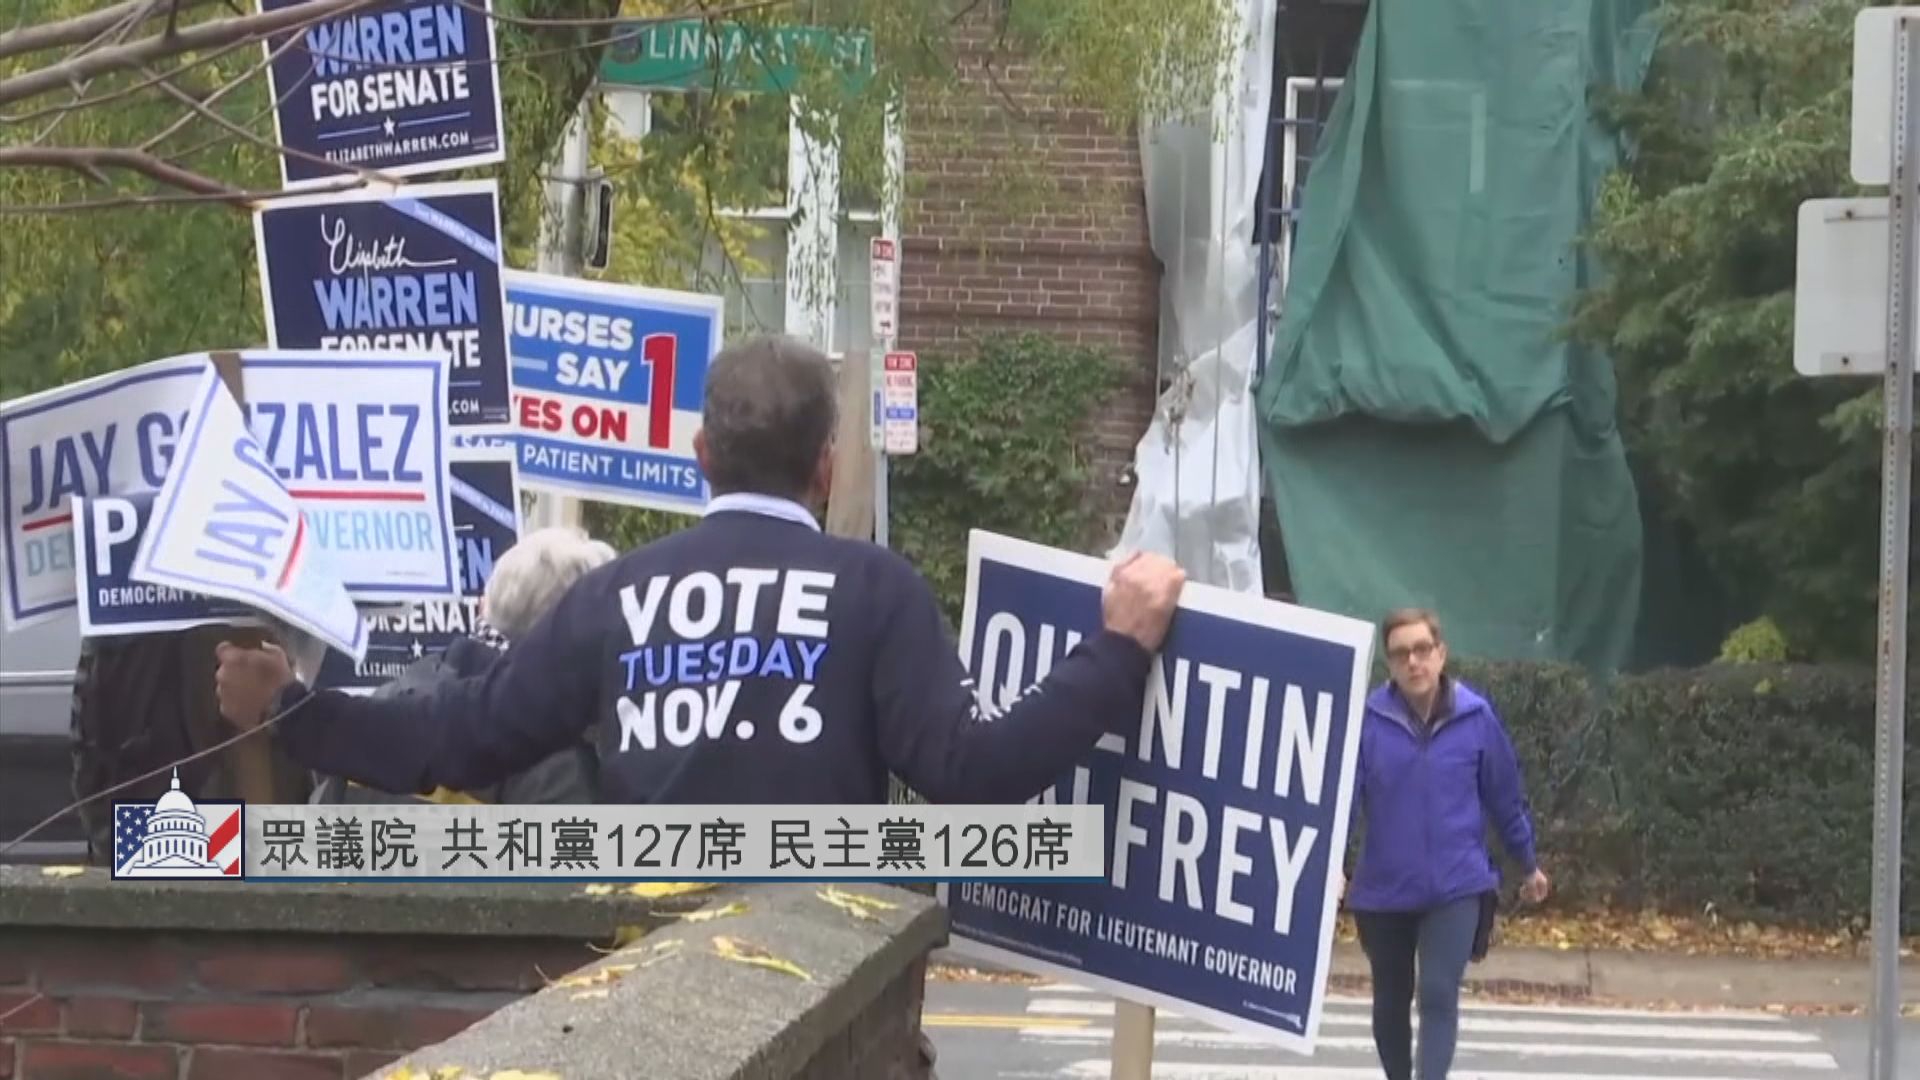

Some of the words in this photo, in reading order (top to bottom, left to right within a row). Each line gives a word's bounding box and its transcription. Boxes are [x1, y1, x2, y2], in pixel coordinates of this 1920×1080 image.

[306, 4, 465, 77] WARREN
[311, 80, 361, 121] FOR
[363, 61, 470, 112] SENATE
[313, 270, 478, 330] WARREN
[555, 352, 629, 392] SAY
[641, 331, 677, 450] 1
[514, 395, 562, 432] ES
[571, 405, 627, 443] ON
[22, 423, 117, 515] JAY
[523, 444, 613, 475] PATIENT
[621, 458, 697, 488] LIMITS
[195, 478, 289, 580] JAY
[303, 509, 435, 551] VERNOR
[619, 567, 837, 646] VOTE
[619, 638, 828, 692] TUESDAY
[616, 680, 755, 752] NOV.
[778, 684, 823, 744] 6
[961, 881, 1051, 925] DEMOCRAT
[1056, 903, 1092, 937] FOR
[1097, 913, 1200, 966] LIEUTENANT
[1204, 945, 1297, 995] GOVERNOR
